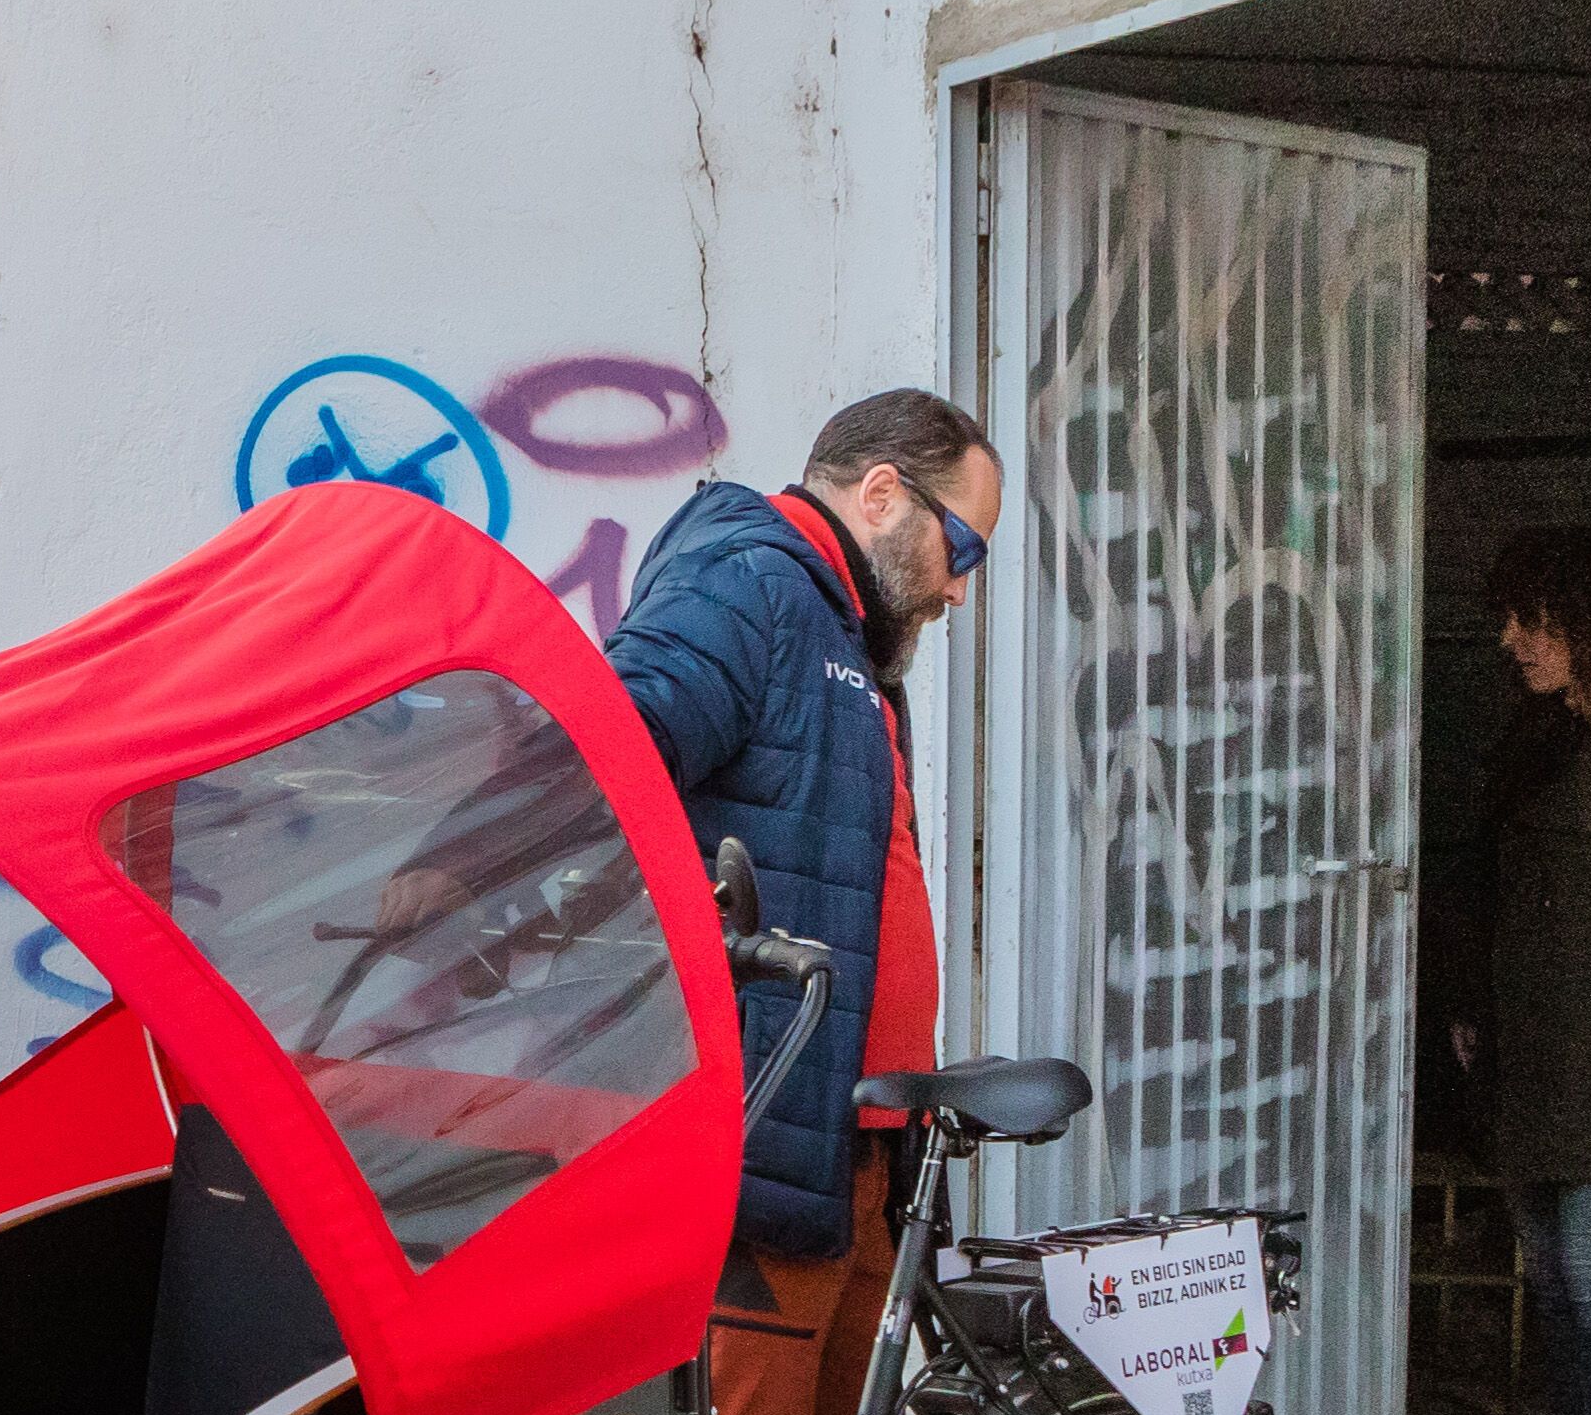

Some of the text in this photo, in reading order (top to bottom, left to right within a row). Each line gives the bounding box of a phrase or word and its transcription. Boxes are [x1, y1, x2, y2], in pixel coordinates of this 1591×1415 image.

[1131, 1249, 1246, 1286] EN BICI SIN EDAD
[1138, 1273, 1247, 1309] BIZIZ, ADINIK EZ
[1121, 1341, 1211, 1378] LABORAL
[1176, 1367, 1214, 1387] kutxa
